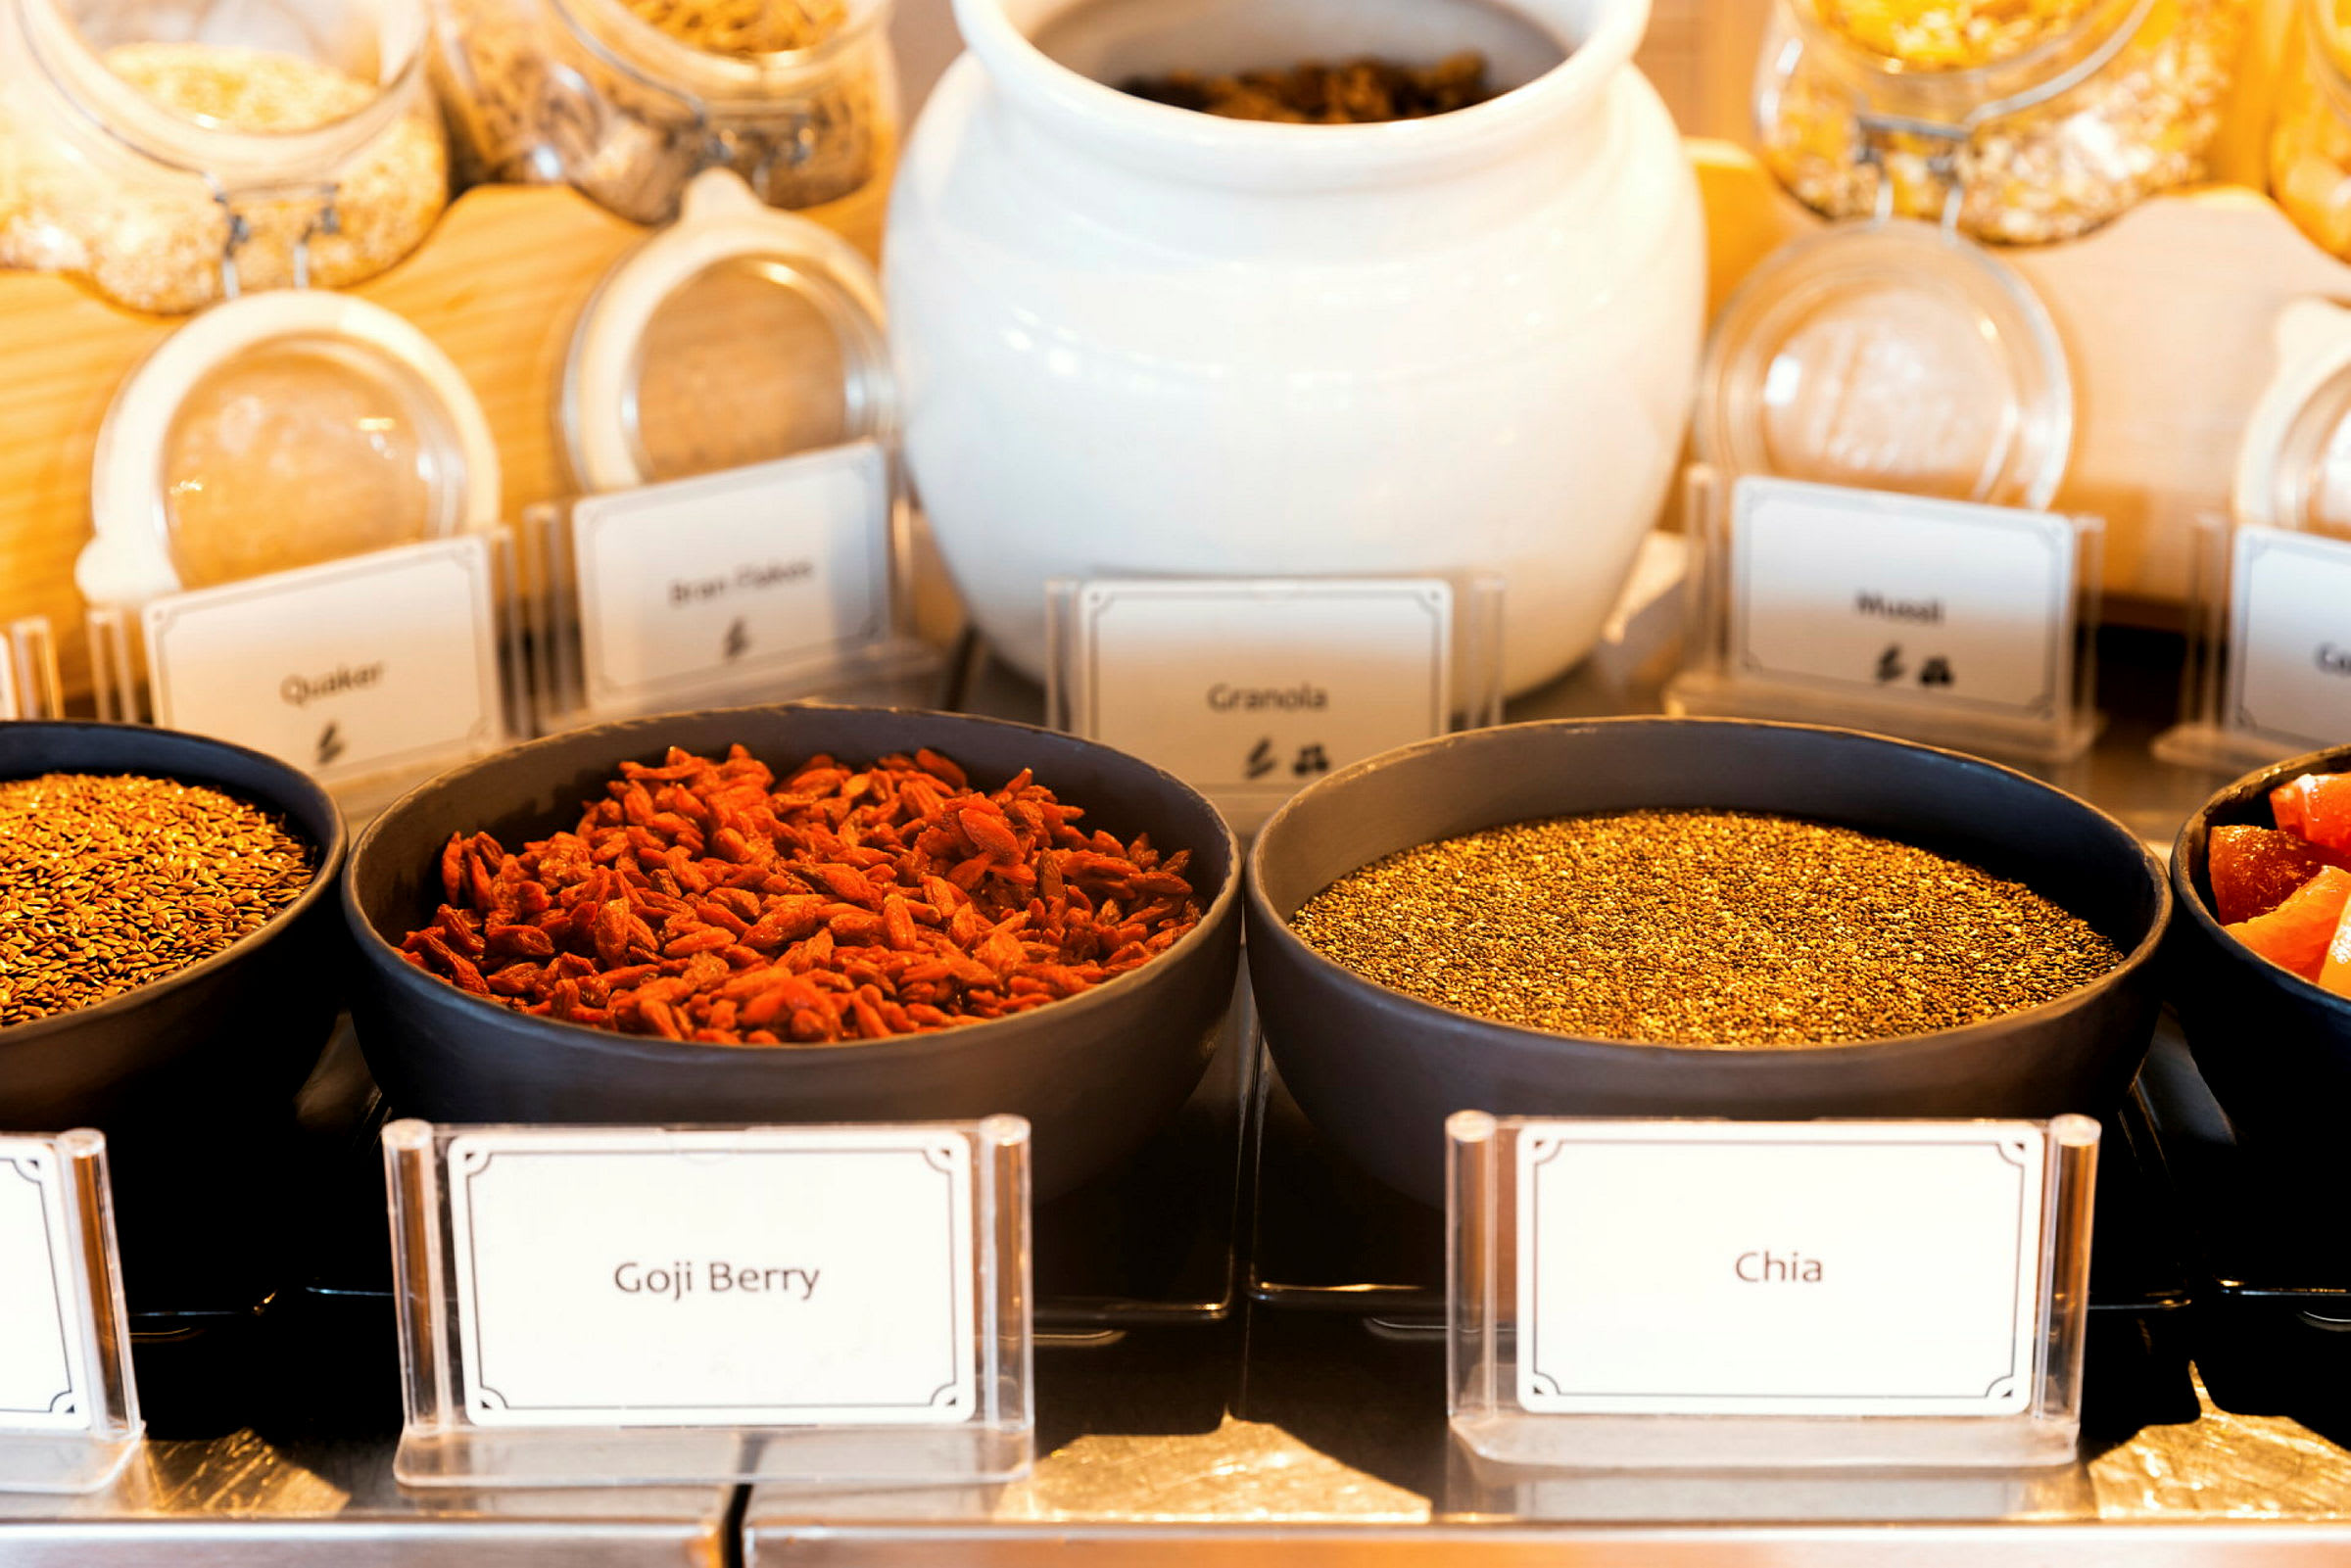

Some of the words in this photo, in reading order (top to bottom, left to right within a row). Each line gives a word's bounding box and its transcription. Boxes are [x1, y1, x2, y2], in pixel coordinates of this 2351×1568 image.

[280, 660, 386, 707] Quaker
[1206, 682, 1329, 713] Granola
[614, 1260, 693, 1302] Goji
[708, 1261, 821, 1302] Berry
[1735, 1251, 1823, 1283] Chia
